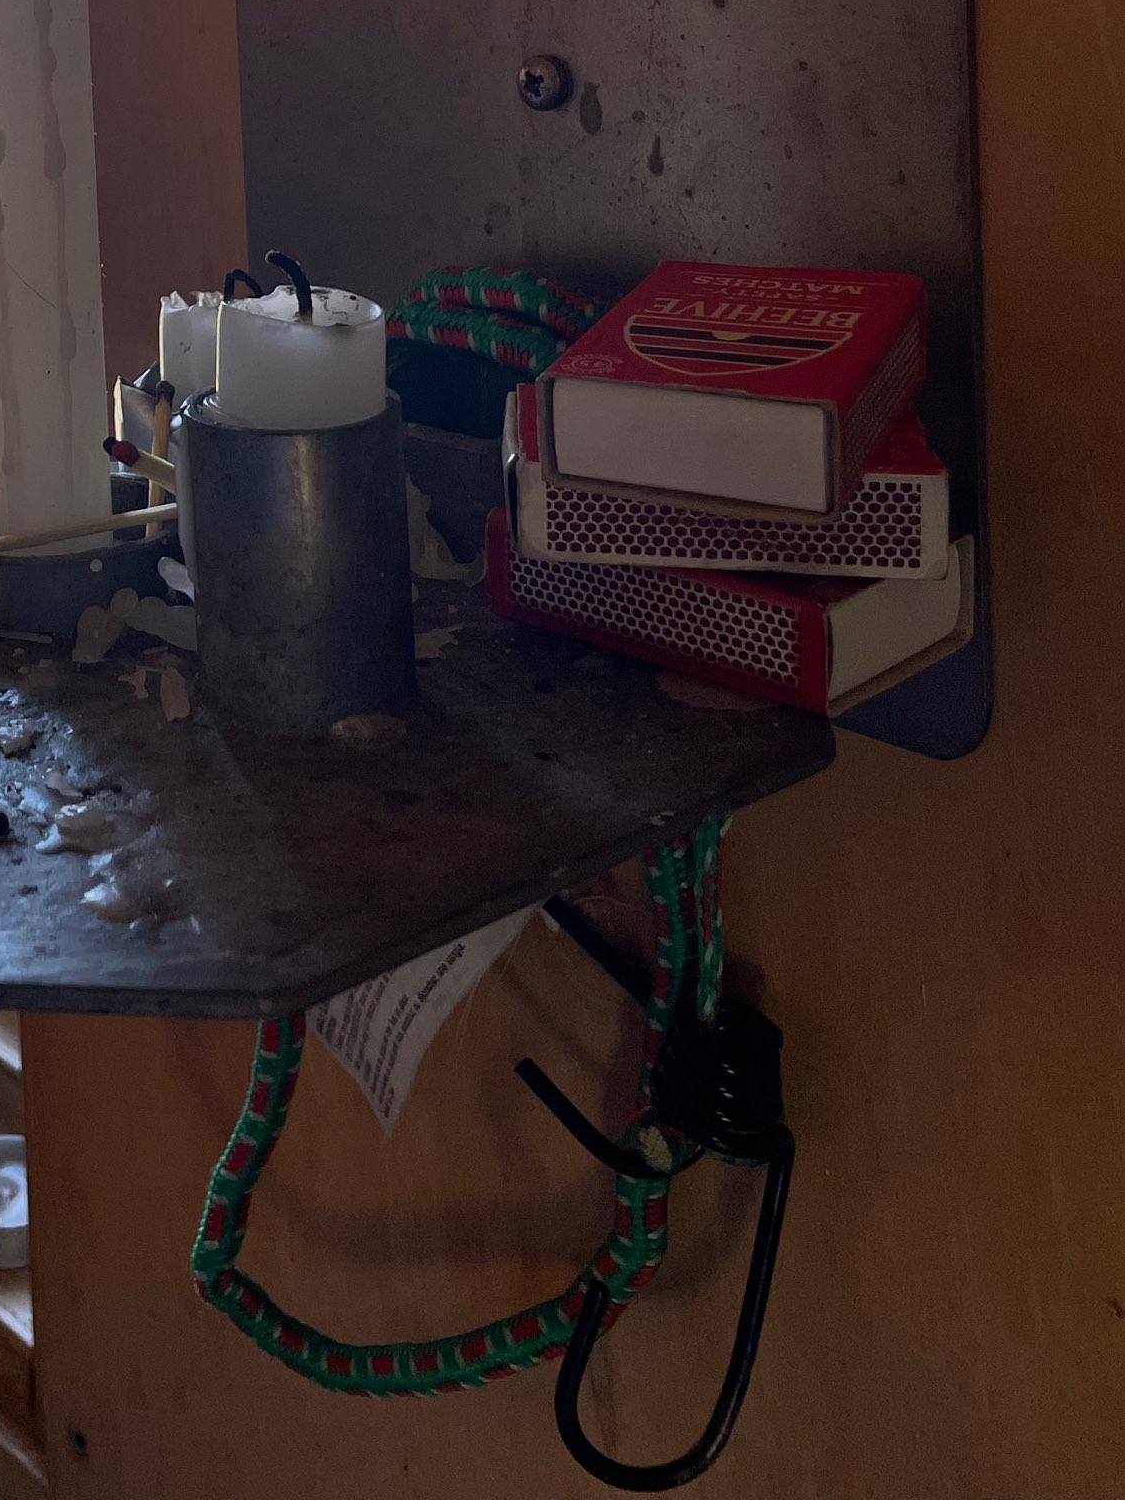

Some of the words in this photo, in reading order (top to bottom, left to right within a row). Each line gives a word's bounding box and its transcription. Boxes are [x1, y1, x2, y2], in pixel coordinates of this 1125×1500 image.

[693, 275, 864, 294] MATCHES
[714, 288, 821, 301] SAFETY
[645, 298, 862, 328] BEEHIVE
